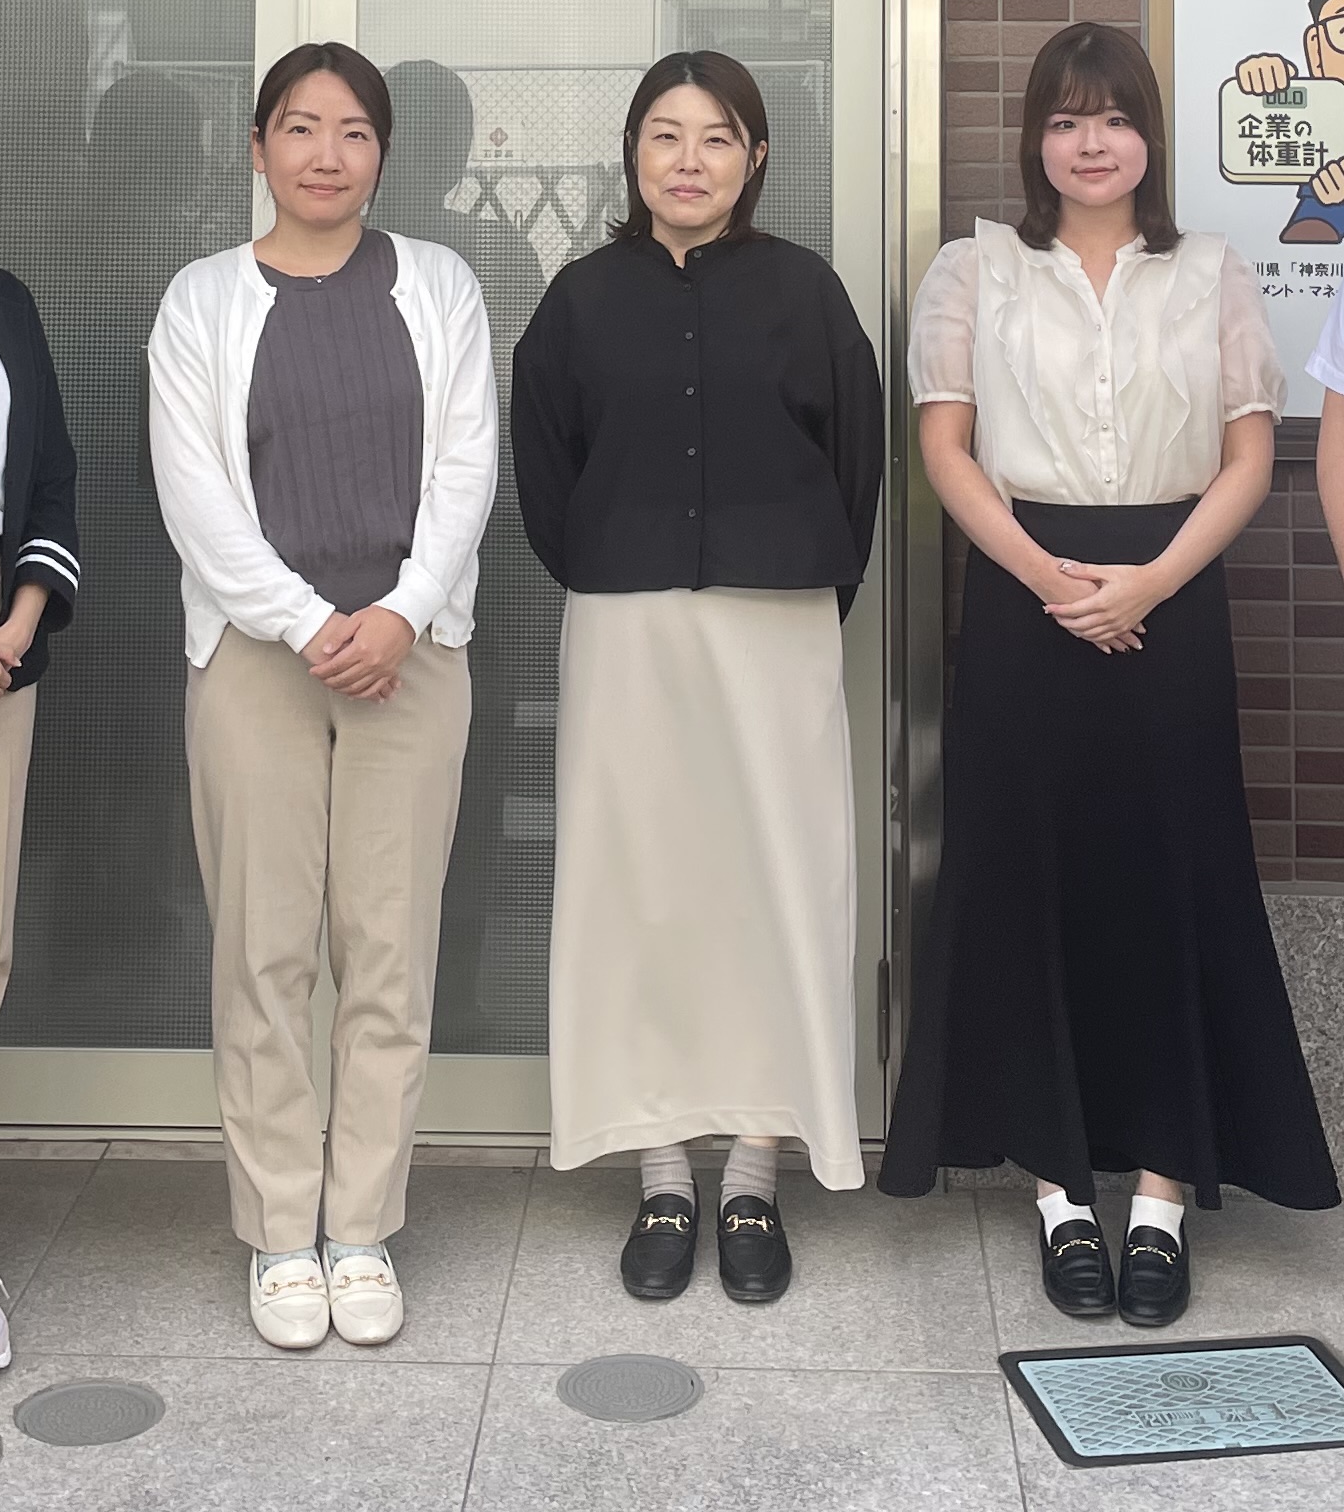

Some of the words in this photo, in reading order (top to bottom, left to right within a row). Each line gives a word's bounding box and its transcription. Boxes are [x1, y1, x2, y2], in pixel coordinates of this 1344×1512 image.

[1237, 112, 1313, 140] 企業の
[1246, 140, 1329, 169] 体重計
